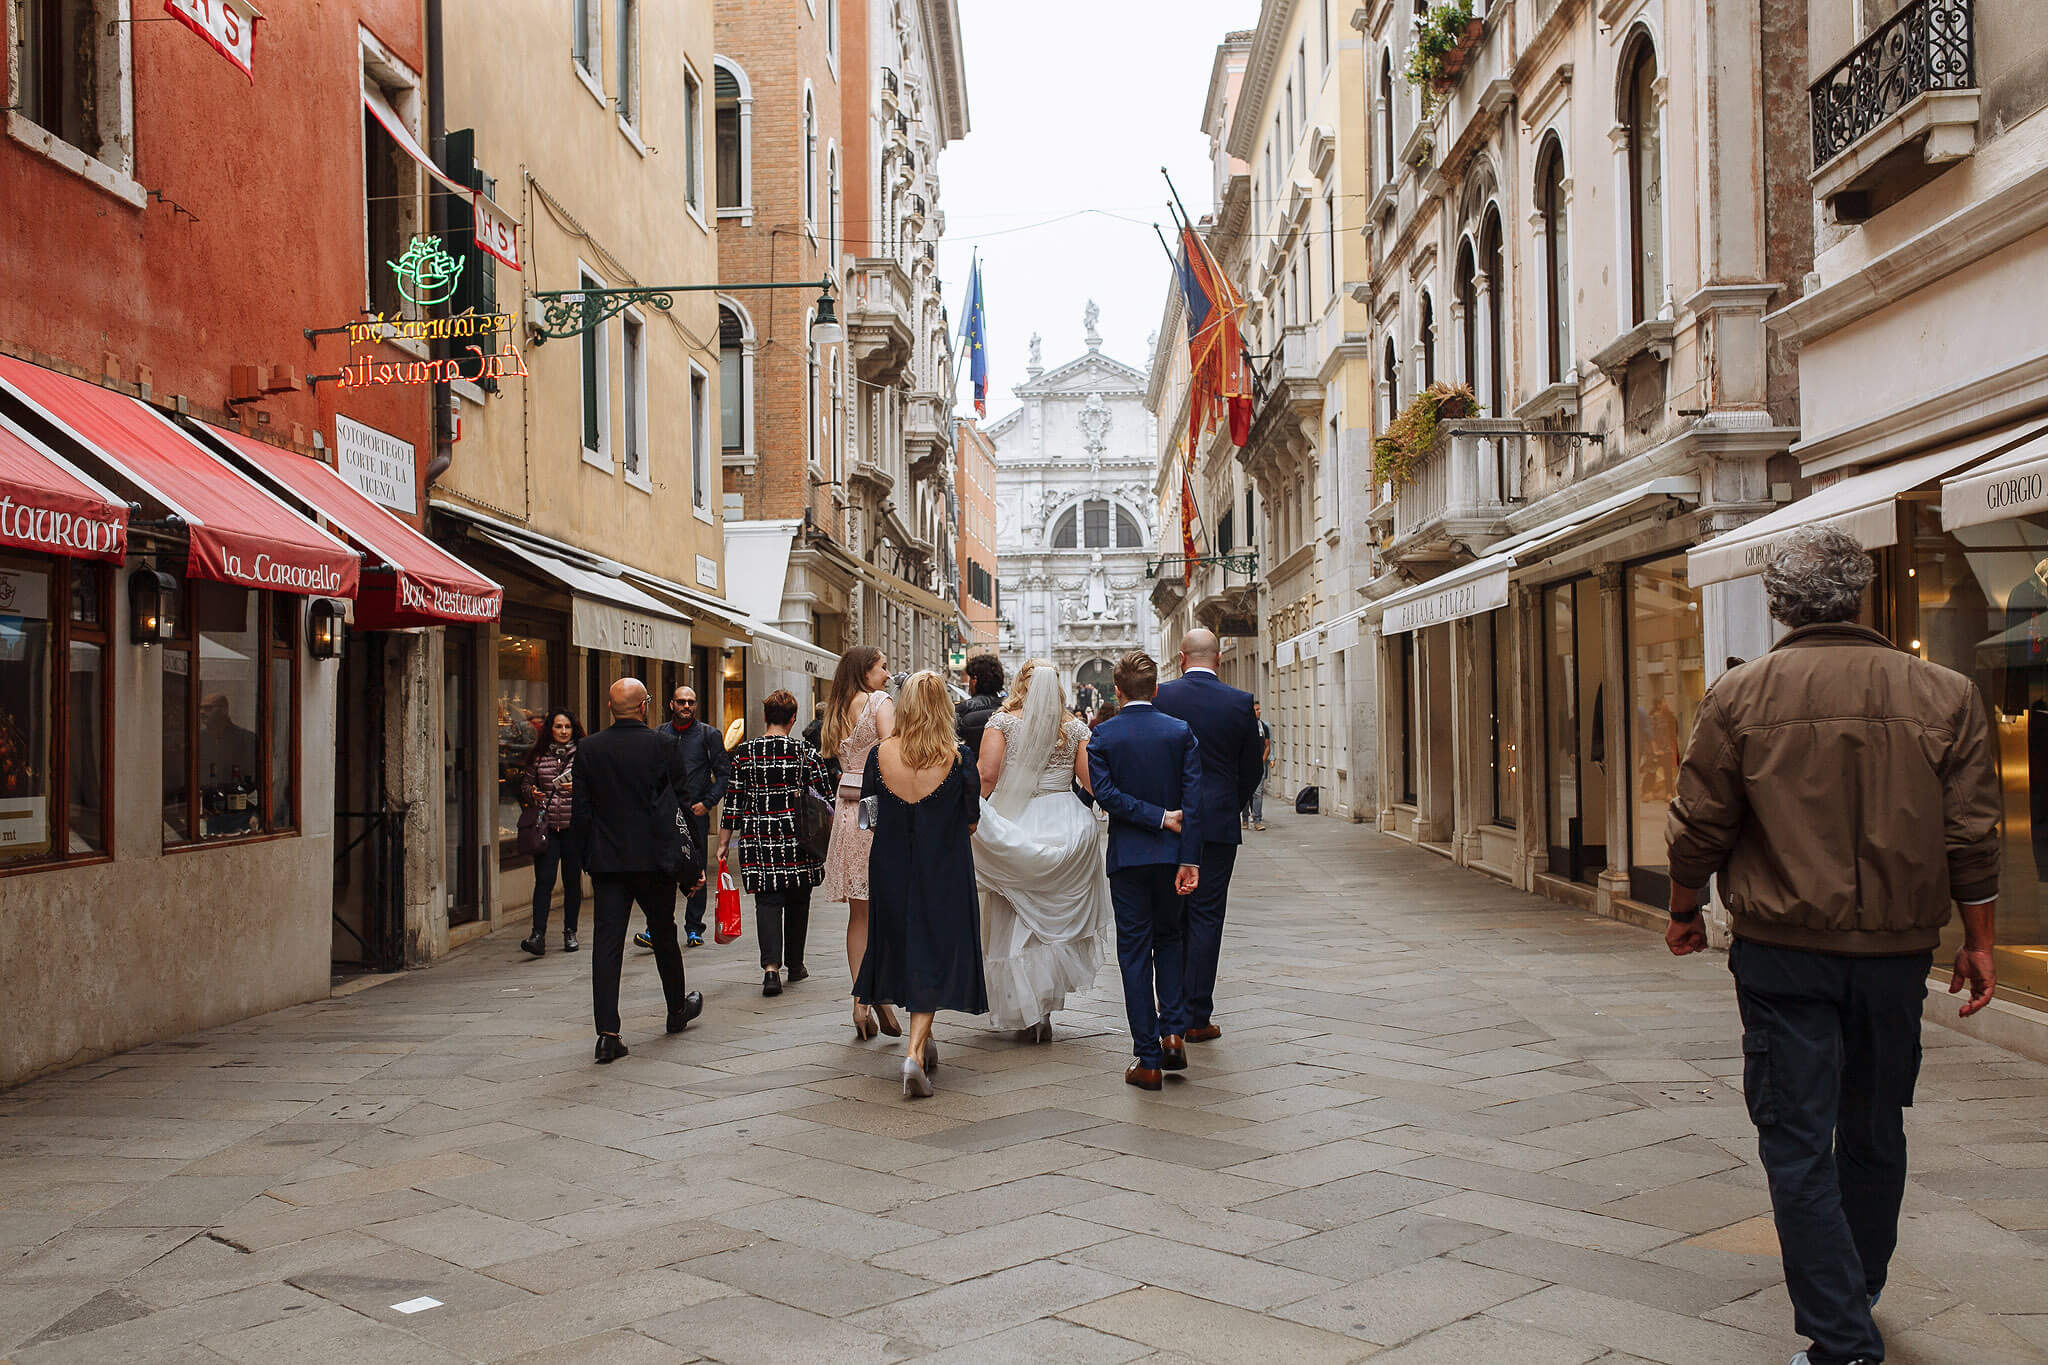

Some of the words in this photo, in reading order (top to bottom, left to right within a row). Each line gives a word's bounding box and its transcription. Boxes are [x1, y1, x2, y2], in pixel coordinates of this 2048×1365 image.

[482, 208, 508, 251] HS
[337, 423, 404, 464] SOTOPORTEGO
[346, 447, 377, 474] CORTE
[380, 459, 392, 480] DE
[395, 465, 407, 484] LA
[359, 474, 396, 502] VICENZA
[1987, 473, 2042, 510] GIORGIO
[1402, 600, 1434, 627] FABIANA
[1439, 585, 1477, 618] FILIPPI
